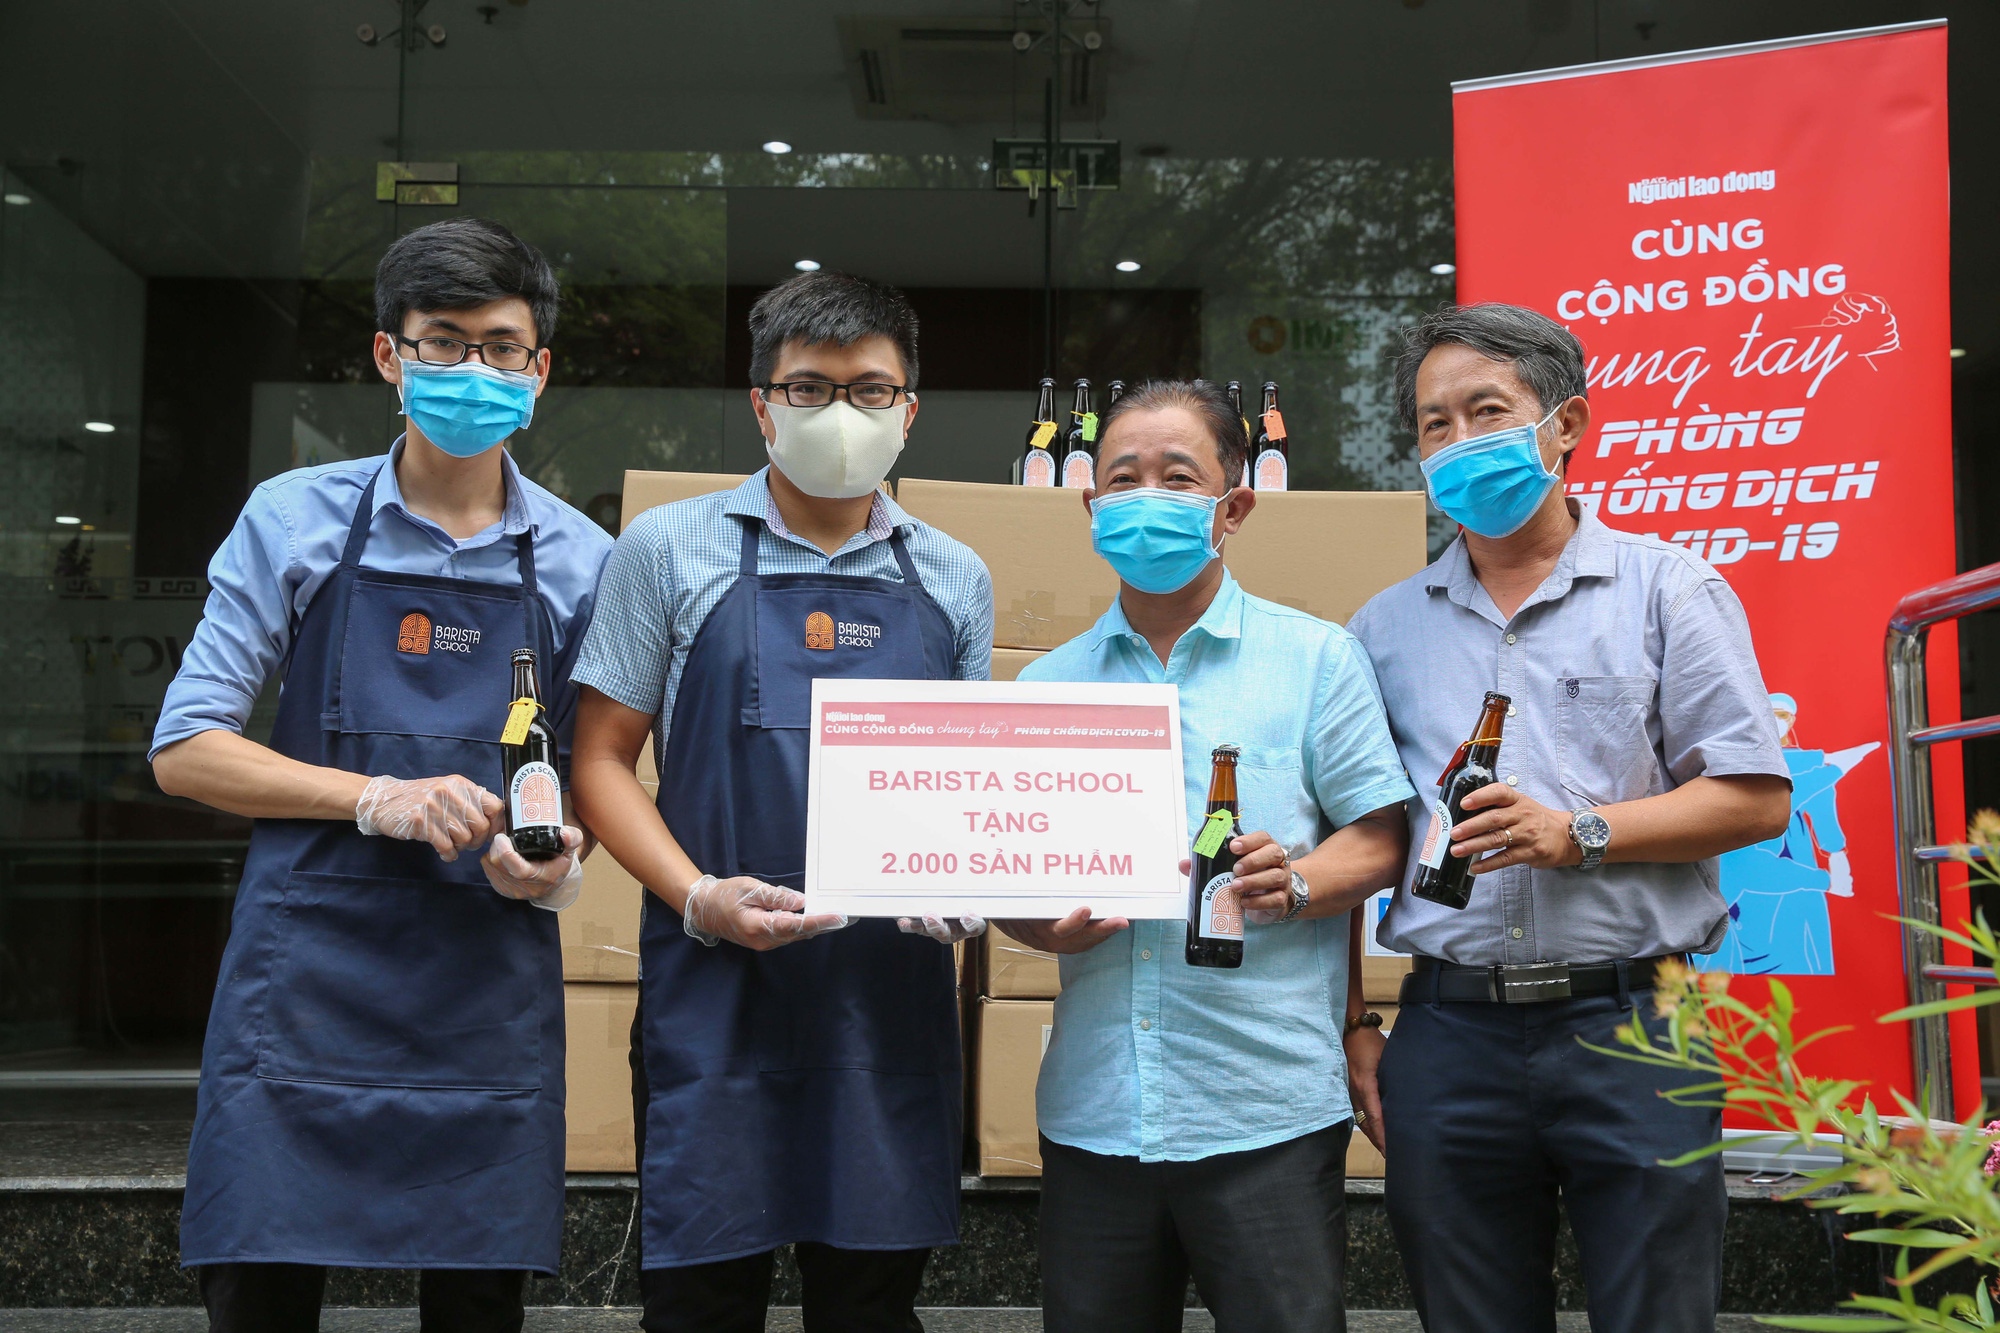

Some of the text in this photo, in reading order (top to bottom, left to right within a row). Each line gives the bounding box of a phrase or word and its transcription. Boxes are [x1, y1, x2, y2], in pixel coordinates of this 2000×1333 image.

[1008, 147, 1105, 186] EIT
[1688, 175, 1720, 197] lao
[1631, 218, 1764, 260] CÙNG
[1556, 258, 1846, 324] CỘNG ĐỒNG
[1730, 313, 1849, 399] tay
[1596, 403, 1806, 458] PHÒNG
[1563, 461, 1880, 516] HỐNG DỊCH
[435, 625, 481, 645] BARISTA
[838, 621, 881, 639] BARISTA
[838, 635, 874, 648] SCHOOL
[433, 639, 472, 653] SCHOOL
[824, 720, 1166, 739] CÙNG CỘNG ĐỒNG chung tay PHÒNG CHỐNG DỊCH COVID-19
[513, 766, 559, 794] BARISTA SCHOOL
[869, 770, 1143, 793] BARISTA SCHOOL
[963, 808, 1049, 838] TẶNG
[1435, 804, 1449, 833] SCHOOL
[881, 848, 1133, 875] 2.000 SẢN PHẨM
[1204, 876, 1231, 901] BARISTA
